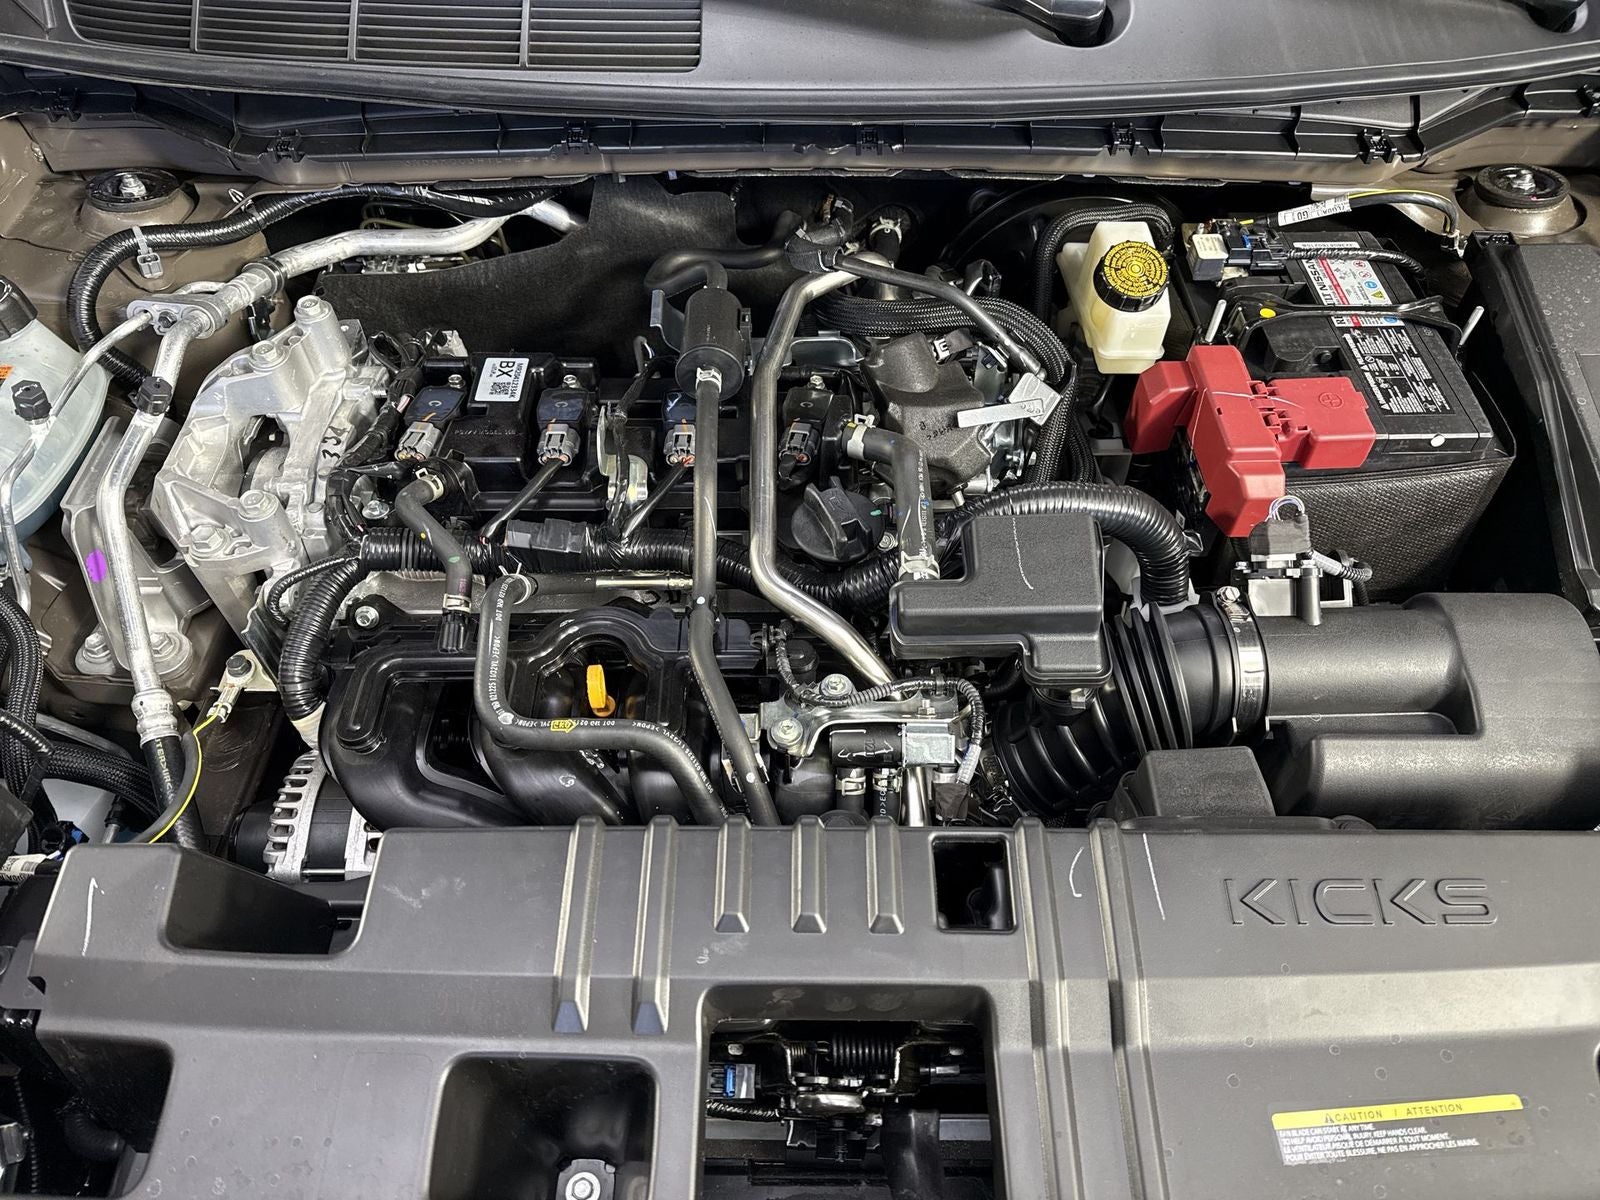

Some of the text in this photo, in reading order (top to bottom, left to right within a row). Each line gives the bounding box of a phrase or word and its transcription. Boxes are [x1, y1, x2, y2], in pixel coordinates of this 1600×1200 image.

[496, 360, 515, 378] BX
[1223, 878, 1498, 926] KICKS
[1334, 1109, 1383, 1122] CAUTION
[1405, 1103, 1464, 1117] ATTENTION
[1290, 1137, 1305, 1145] HELP
[1373, 1130, 1387, 1138] KEEP
[1387, 1128, 1407, 1136] HANDS
[1407, 1126, 1427, 1134] CLEAR.
[1348, 1124, 1360, 1132] ANY
[1355, 1139, 1364, 1147] DE
[1404, 1135, 1420, 1143] TOUT
[1421, 1132, 1451, 1142] MOMENT.
[1285, 1153, 1304, 1162] POUR
[1377, 1146, 1386, 1154] NE
[1386, 1145, 1399, 1153] PAS
[1399, 1144, 1409, 1152] EN
[1408, 1141, 1445, 1151] APPROCHER
[1445, 1140, 1457, 1148] LES
[1456, 1137, 1480, 1147] MAINS.
